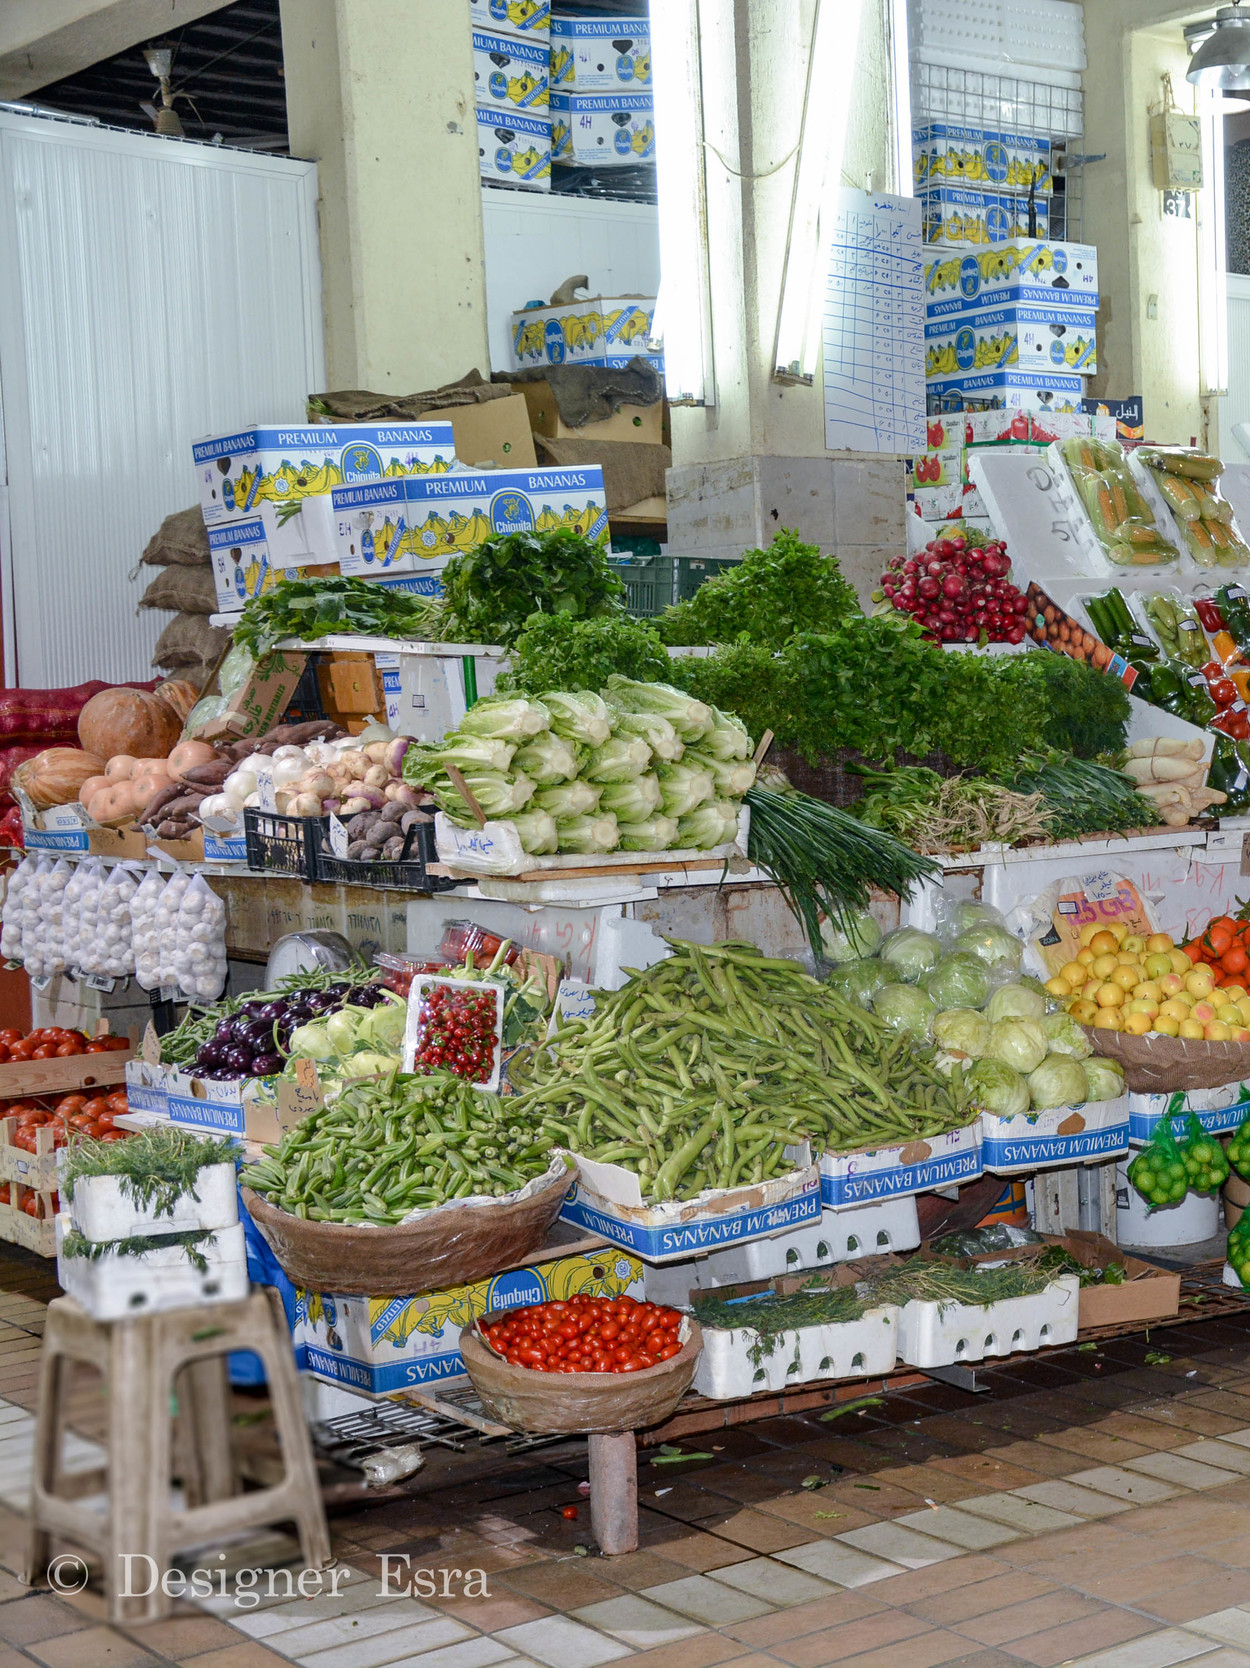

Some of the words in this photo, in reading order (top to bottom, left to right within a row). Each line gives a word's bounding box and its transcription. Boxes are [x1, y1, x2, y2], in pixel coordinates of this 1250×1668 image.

[575, 23, 621, 34] PREMIUM
[500, 42, 545, 61] BANANAS
[576, 98, 620, 110] PREMIUM
[505, 116, 548, 134] BANANAS
[579, 115, 592, 129] 4H
[947, 127, 983, 140] PREMIUM
[1005, 136, 1038, 149] BANANAS
[952, 192, 984, 205] PREMIUM
[1007, 201, 1038, 213] BANANS
[1166, 199, 1185, 216] 37
[981, 291, 1010, 305] PREMIUM
[1023, 290, 1060, 300] BANANAS
[1062, 294, 1096, 305] PREMIUM
[934, 303, 962, 314] BANANAS
[1018, 310, 1052, 321] PREMIUM
[1053, 313, 1092, 324] BANANAS
[928, 321, 956, 335] PREMIUM
[975, 312, 1005, 326] BANANAS
[963, 377, 995, 388] BANANAS
[1008, 375, 1044, 386] PREMIUM
[1045, 378, 1079, 389] BANANAS
[1115, 403, 1139, 421] النيل
[278, 431, 338, 445] PREMIUM
[377, 429, 433, 442] BANANAS
[194, 443, 222, 460] PREMIUM
[223, 435, 256, 453] BANANAS
[346, 471, 381, 483] Chiquita
[426, 480, 487, 495] PREMIUM
[528, 474, 586, 488] BANANAS
[333, 490, 364, 506] PREMIUM
[364, 484, 398, 500] BANANAS
[209, 530, 234, 546] PREMIUM
[234, 524, 261, 541] BANANAS
[496, 519, 532, 534] Chiquita
[57, 836, 80, 848] PREMIUM
[170, 1102, 202, 1121] BANANAS
[203, 1108, 238, 1127] PREMIUM
[1005, 1142, 1067, 1162] BANANAS
[1069, 1131, 1125, 1155] PREMIUM
[917, 1158, 978, 1183] PREMIUM
[844, 1170, 914, 1200] BANANAS
[747, 1198, 817, 1232] PREMIUM
[582, 1210, 635, 1246] PREMIUM
[663, 1219, 743, 1250] BANANAS
[493, 1286, 541, 1309] Chiquita
[308, 1350, 342, 1377] BANANAS
[341, 1363, 372, 1388] PREMIUM
